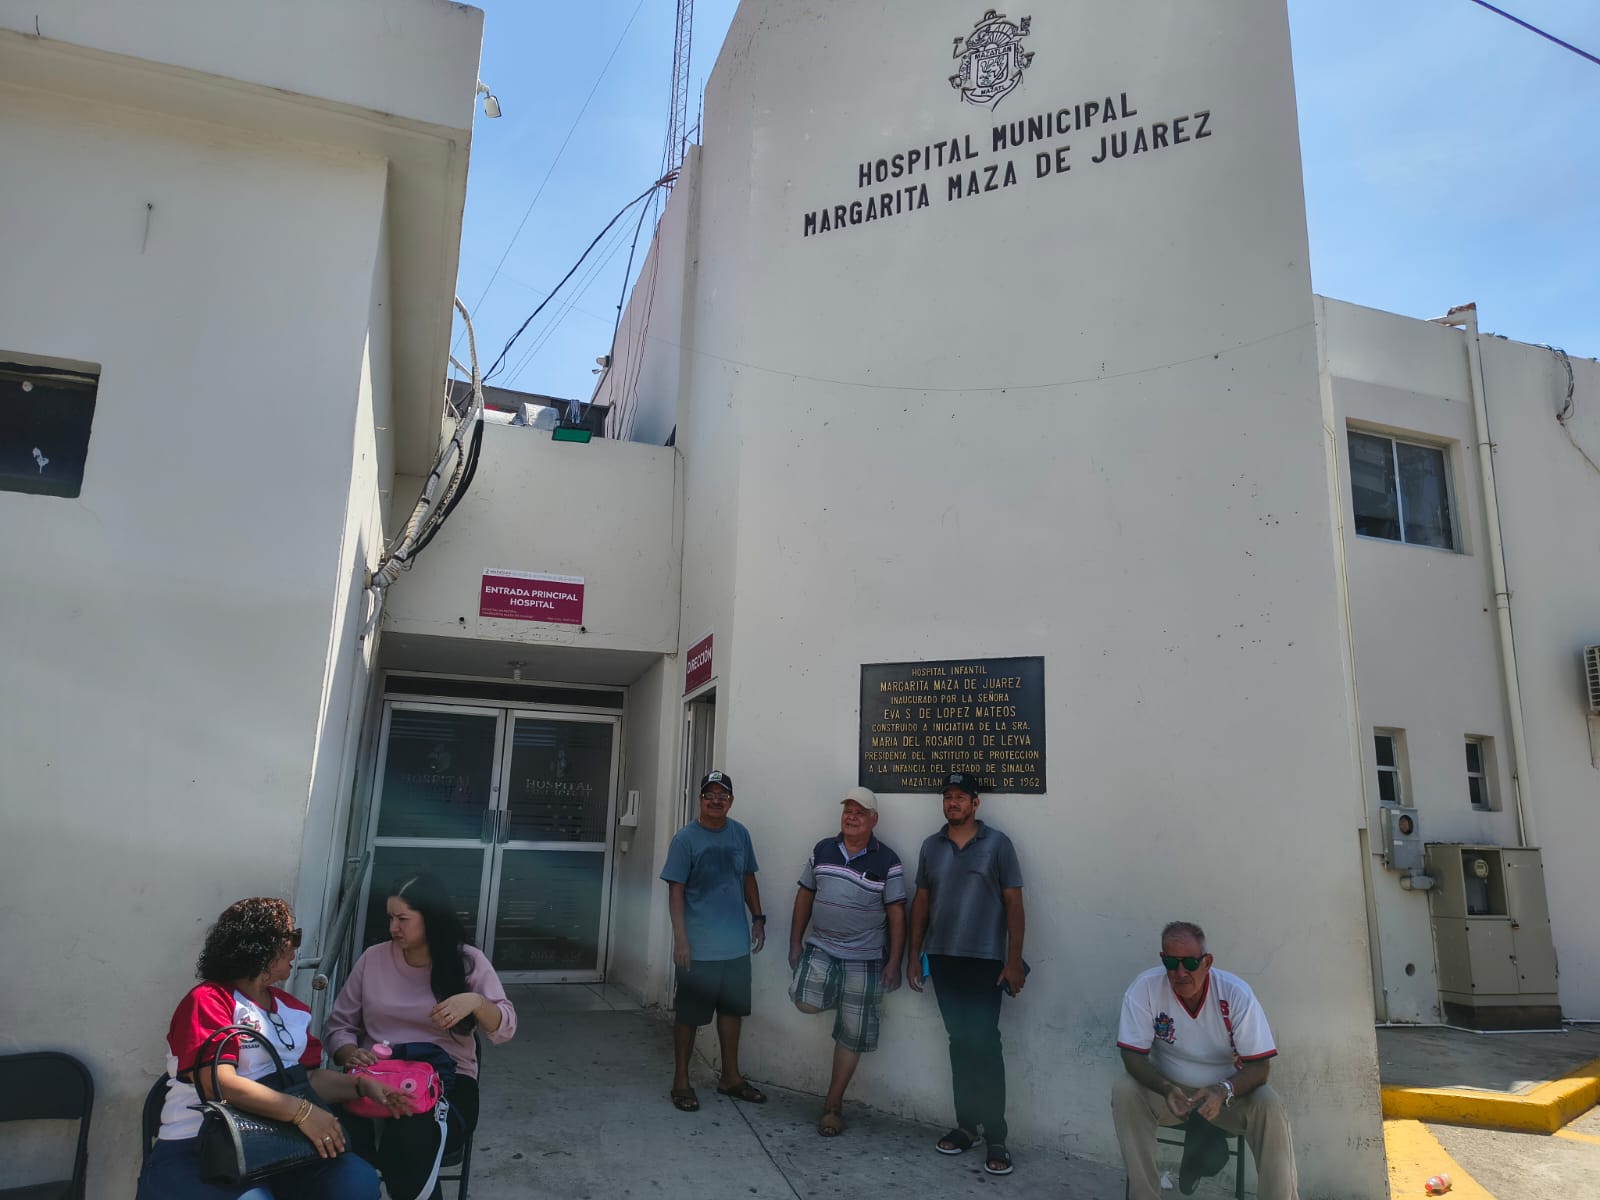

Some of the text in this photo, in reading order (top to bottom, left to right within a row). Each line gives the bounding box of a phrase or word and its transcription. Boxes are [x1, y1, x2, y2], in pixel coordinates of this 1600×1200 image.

[975, 46, 1012, 60] MAZATLAN
[858, 93, 1138, 188] HOSPITAL MUNICIPAL
[804, 110, 1212, 237] MARGARITA MAZA DE JUAREZ
[485, 586, 578, 601] ENTRADA PRINCIPAL
[510, 598, 555, 609] HOSPITAL
[687, 644, 712, 674] DIRECCIÓN
[912, 666, 987, 676] HOSPITAL INFANTIL
[880, 677, 1021, 692] MARGARITA MAZA DE JUAREZ
[891, 691, 1009, 704] INAUGURADO POR LA SEÑORA
[884, 706, 1016, 720] EVA S DE LOPEZ MATEOS
[872, 723, 918, 732] CONSTRUIDO
[923, 723, 928, 732] A
[933, 722, 974, 731] INICIATIVA
[979, 722, 990, 731] DE
[996, 722, 1006, 731] LA
[872, 736, 898, 747] MARIA
[903, 736, 920, 746] DEL
[925, 735, 963, 747] ROSARIO
[983, 735, 995, 746] DE
[1001, 735, 1030, 746] LEYVA
[864, 751, 1039, 760] PRESIDENTA DEL INSTITUTO DE PROTECCION
[869, 764, 1035, 772] A LA INFANCIA DEL ESTADO DE SINALOA
[526, 778, 592, 792] HOSPITAL
[902, 778, 1040, 787] MAZATLAN BRIL DE 1962
